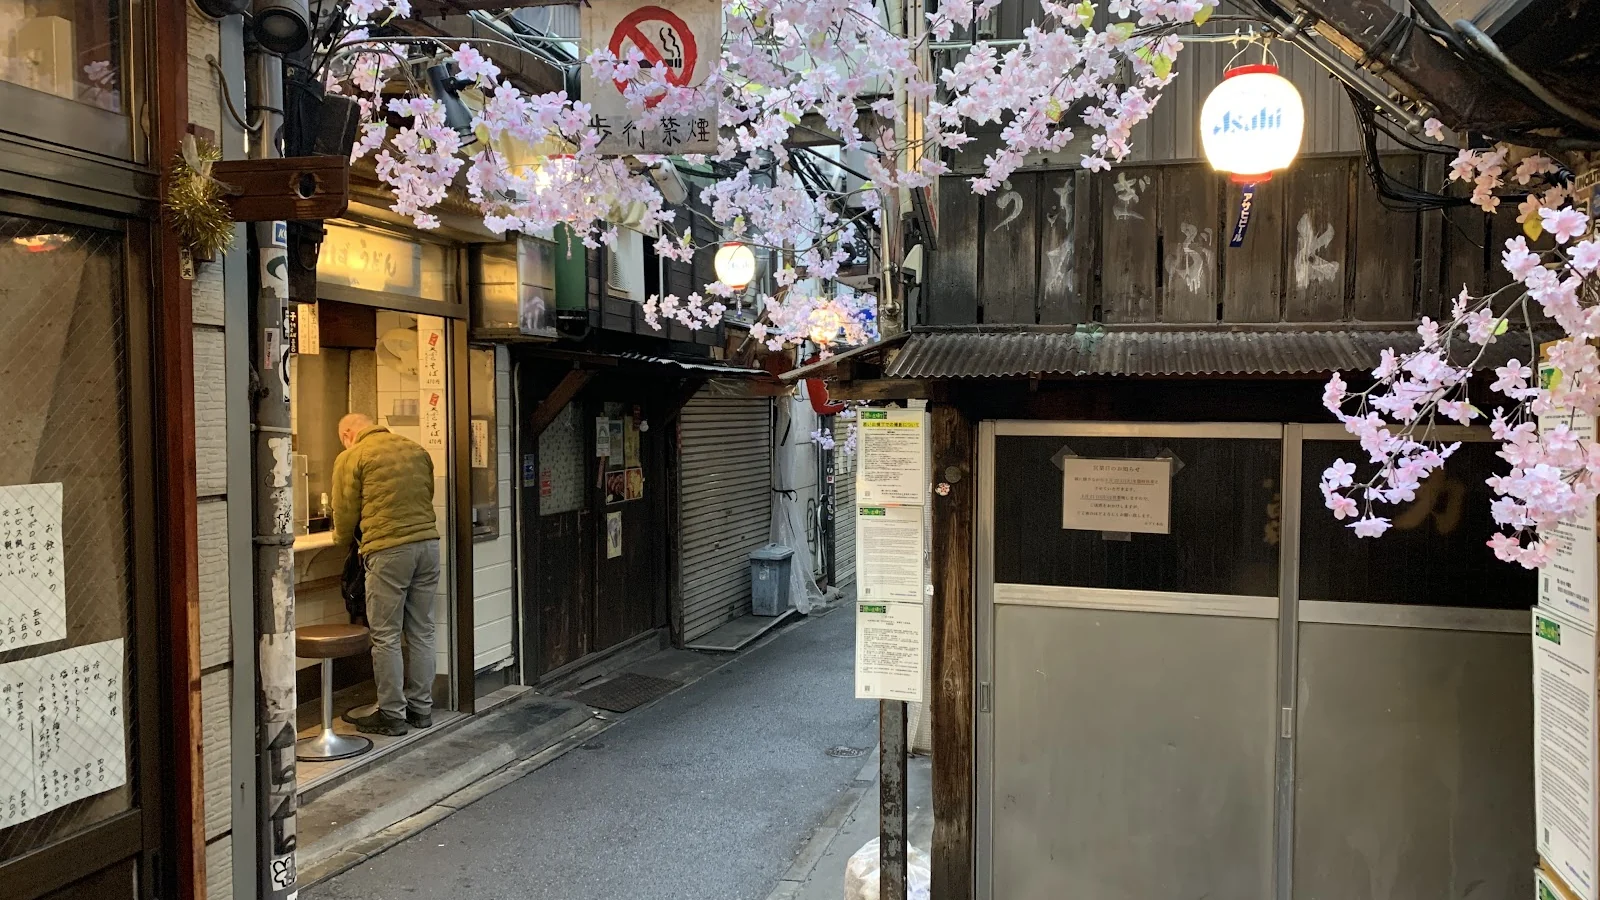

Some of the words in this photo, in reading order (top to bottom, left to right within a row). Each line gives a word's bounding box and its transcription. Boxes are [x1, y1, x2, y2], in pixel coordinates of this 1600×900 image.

[588, 113, 711, 149] 歩行禁煙
[1213, 107, 1281, 135] Asahi
[1232, 193, 1253, 242] アサヒビール
[1093, 465, 1141, 473] 営業日のお知らせ
[44, 523, 57, 592] お飲みもの
[107, 675, 117, 716] お料理
